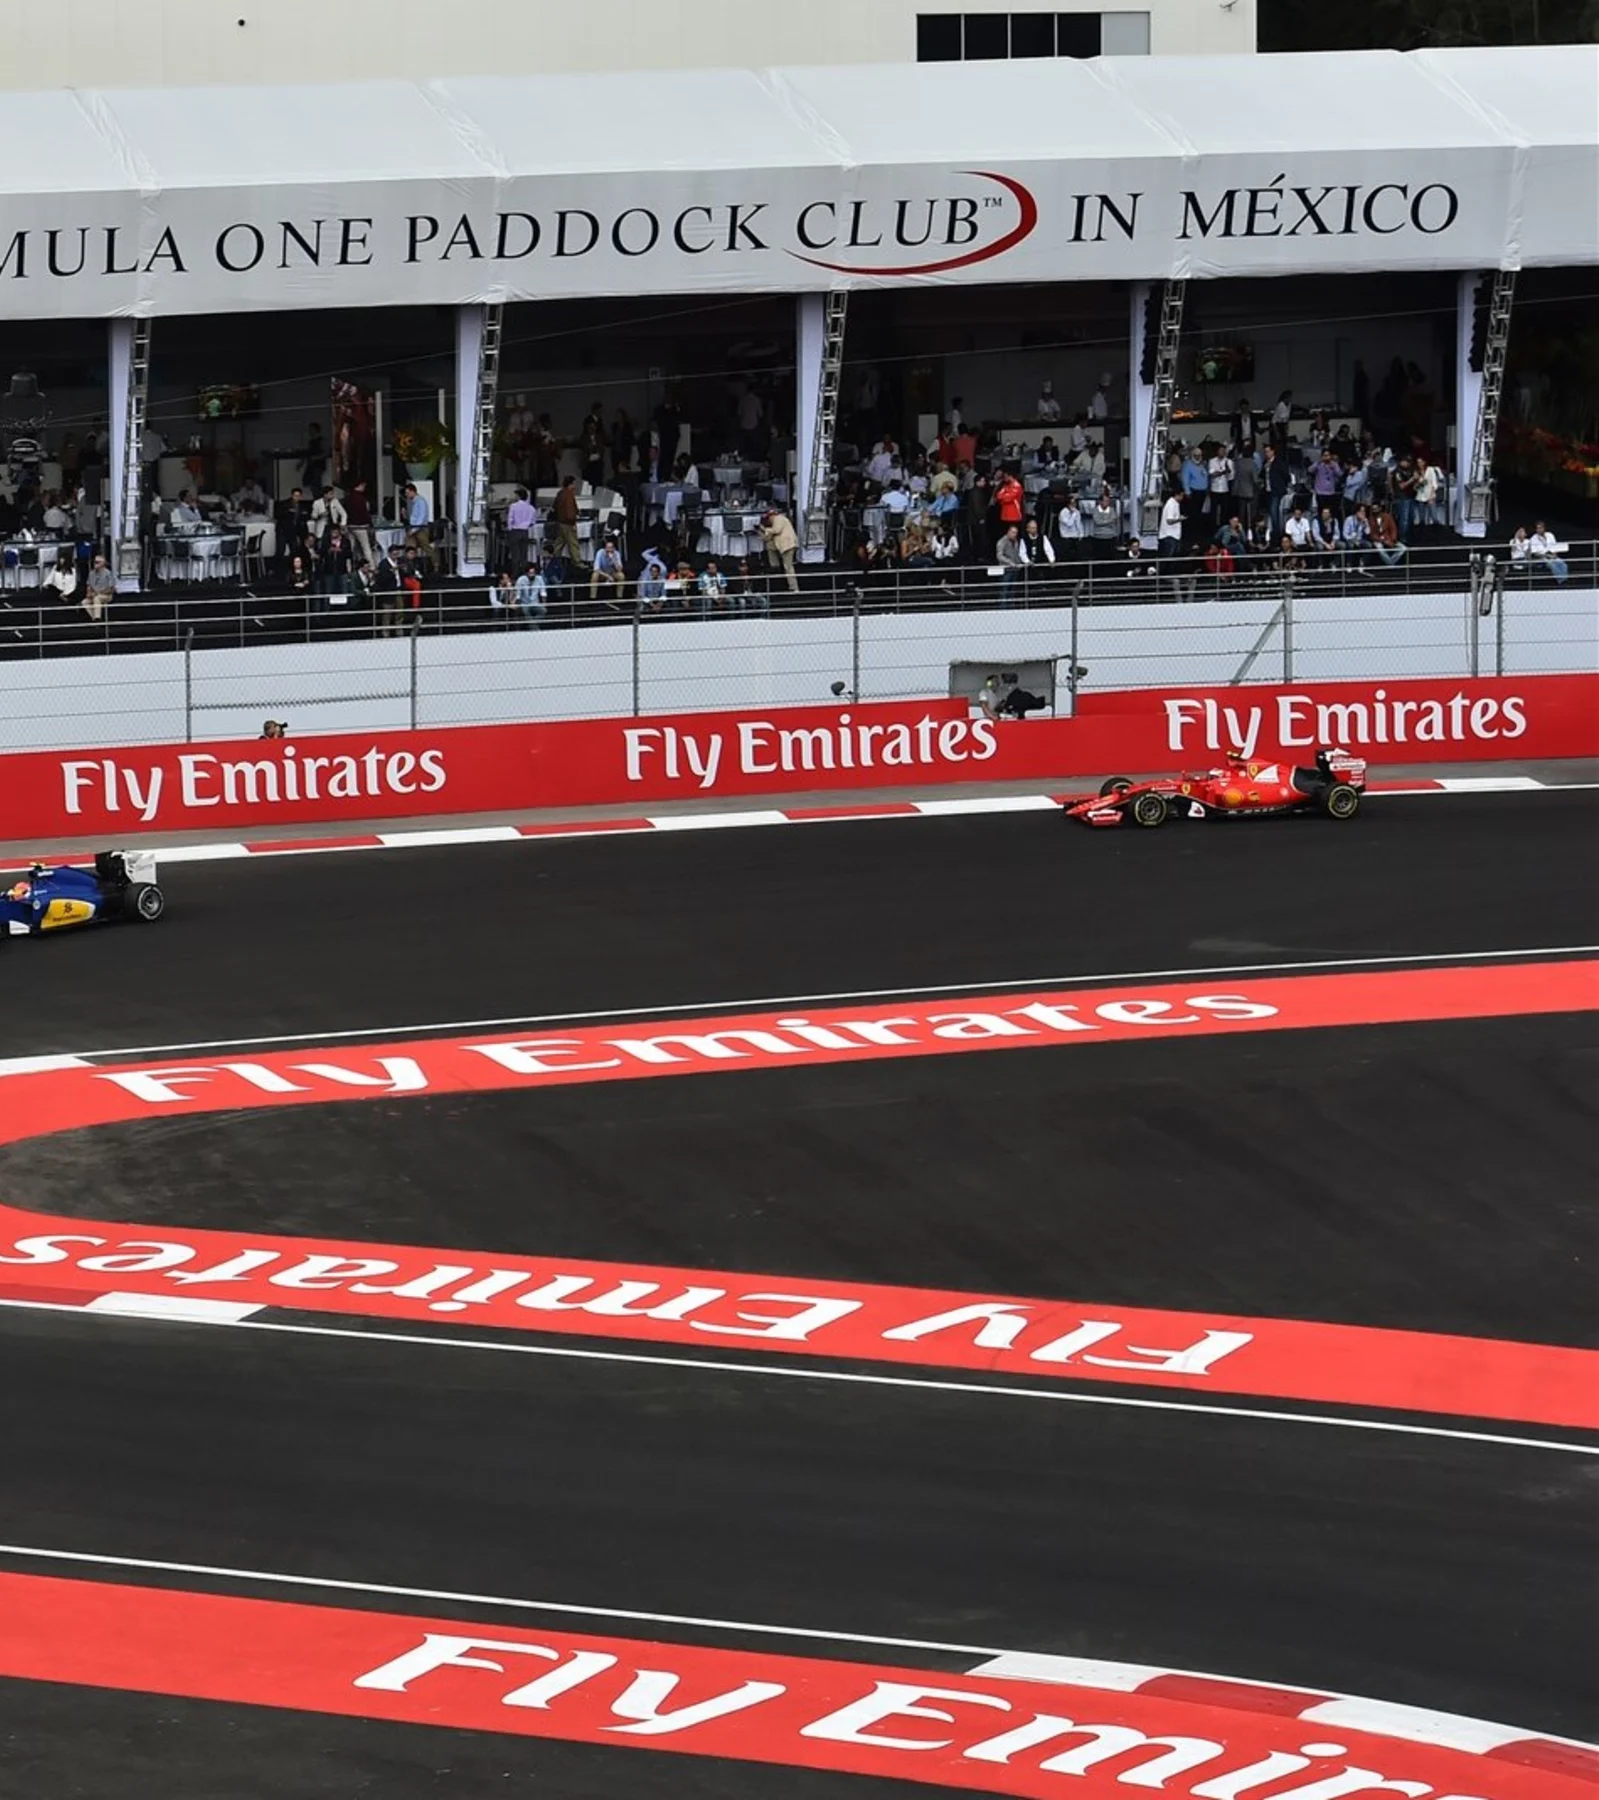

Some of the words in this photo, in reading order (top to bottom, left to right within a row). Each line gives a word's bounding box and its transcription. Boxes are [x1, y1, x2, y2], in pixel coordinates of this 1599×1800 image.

[215, 218, 373, 272] ONE
[405, 203, 769, 263] PADDOCK
[1067, 192, 1143, 243] IN
[1176, 173, 1459, 240] MÉXICO
[623, 727, 722, 788] Fly
[737, 713, 998, 773] Emirates
[1162, 698, 1262, 760] Fly
[1276, 689, 1526, 746] Emirates
[61, 760, 163, 821] Fly
[178, 746, 446, 806] Emirates
[95, 1056, 429, 1103] Fly
[462, 994, 1279, 1075] Emirates
[881, 1302, 1254, 1375] Fly
[353, 1633, 787, 1735] Fly
